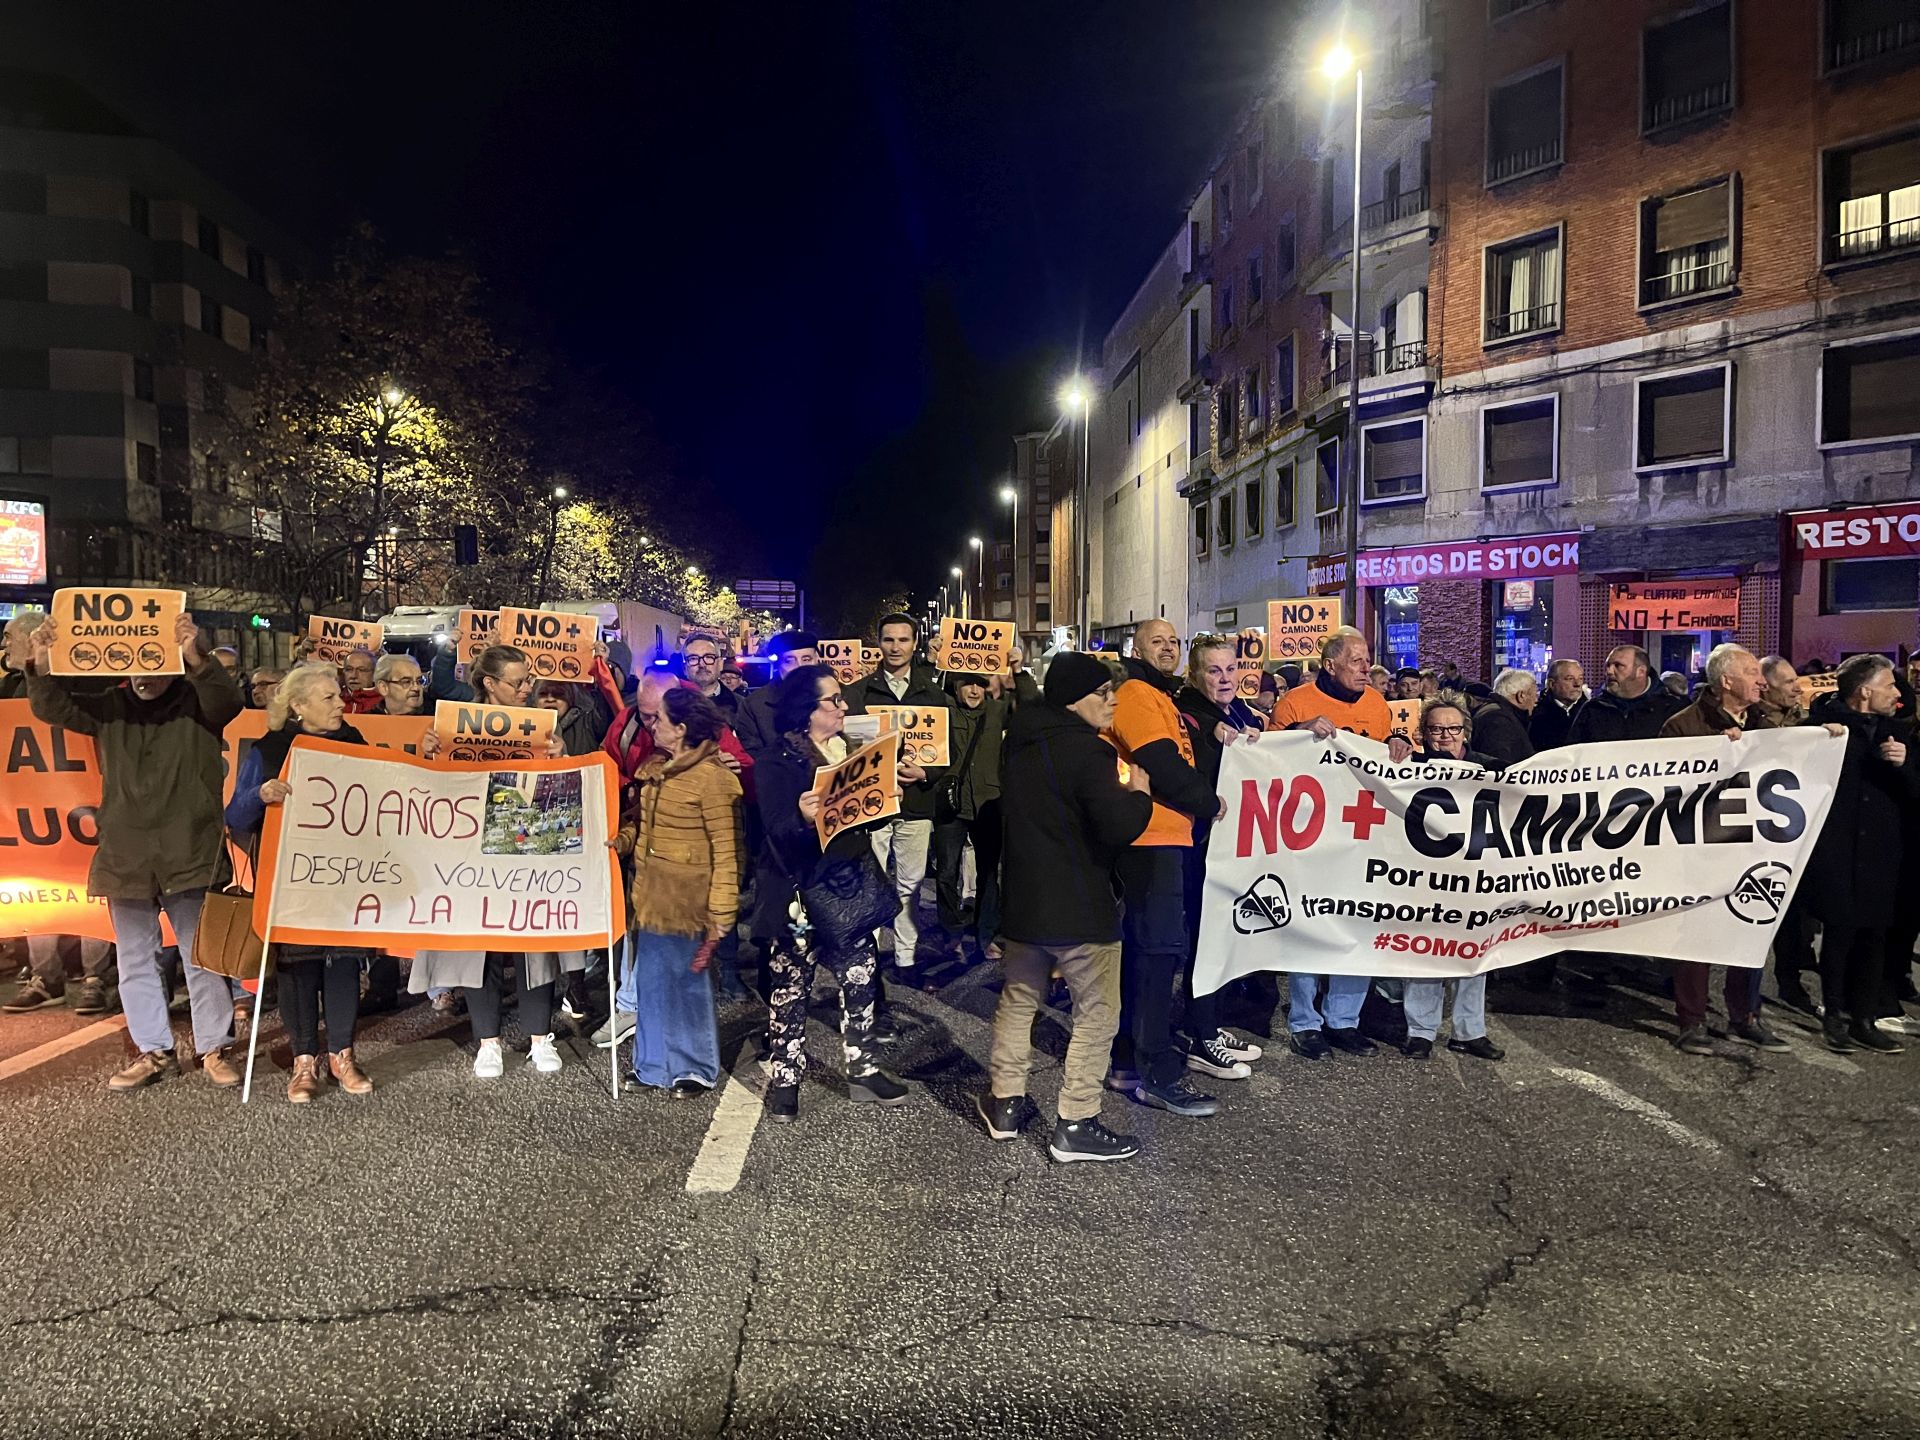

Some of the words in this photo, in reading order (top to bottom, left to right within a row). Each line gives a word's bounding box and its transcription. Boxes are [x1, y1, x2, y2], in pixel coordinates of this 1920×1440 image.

[6, 501, 43, 515] KFC
[1797, 514, 1920, 549] RESTO
[1356, 553, 1443, 578] RESTOS
[1450, 550, 1482, 573] DE
[1488, 542, 1579, 570] STOCK
[1644, 589, 1686, 600] CUATRO
[73, 593, 133, 621] NO
[142, 599, 161, 618] +
[1282, 605, 1314, 624] NO
[1319, 608, 1329, 620] +
[516, 614, 561, 638] NO
[566, 624, 580, 638] +
[1281, 625, 1328, 633] CAMIONES
[1615, 610, 1648, 629] NO
[1657, 609, 1673, 629] +
[71, 625, 159, 636] CAMIONES
[323, 621, 355, 639] NO
[361, 629, 371, 639] +
[953, 623, 987, 641] NO
[992, 629, 1002, 640] +
[320, 638, 368, 649] CAMIONES
[513, 638, 577, 652] CAMIONES
[843, 646, 852, 656] +
[951, 642, 999, 651] CAMIONES
[457, 708, 511, 737] NO
[519, 719, 536, 736] +
[923, 714, 935, 727] +
[453, 737, 531, 747] CAMIONES
[901, 732, 933, 740] IONES
[829, 756, 866, 794] NO
[870, 751, 883, 768] +
[1319, 750, 1453, 781] ASOCIACIÓN
[1458, 769, 1487, 781] DE
[1494, 768, 1567, 784] VECINOS
[1571, 767, 1592, 782] DE
[1597, 765, 1619, 780] LA
[1625, 759, 1719, 778] CALZADA
[824, 774, 880, 807] CAMIONES
[298, 776, 368, 837] 30
[376, 788, 480, 839] AÑOS
[1236, 775, 1326, 857] NO
[1342, 790, 1386, 840] +
[1404, 769, 1806, 860] CAMIONES
[290, 851, 403, 885] DESPUÉS
[435, 861, 582, 893] VOLVEMOS
[1365, 858, 1423, 887] Por
[1429, 872, 1470, 893] un
[1475, 866, 1551, 894] barrio
[1555, 861, 1604, 888] libre
[1609, 857, 1641, 881] de
[354, 893, 381, 925] A
[408, 895, 451, 925] LA
[482, 896, 578, 931] LUCHA
[1301, 895, 1462, 923] transporte
[1466, 900, 1562, 930] pesado
[1563, 902, 1580, 923] y
